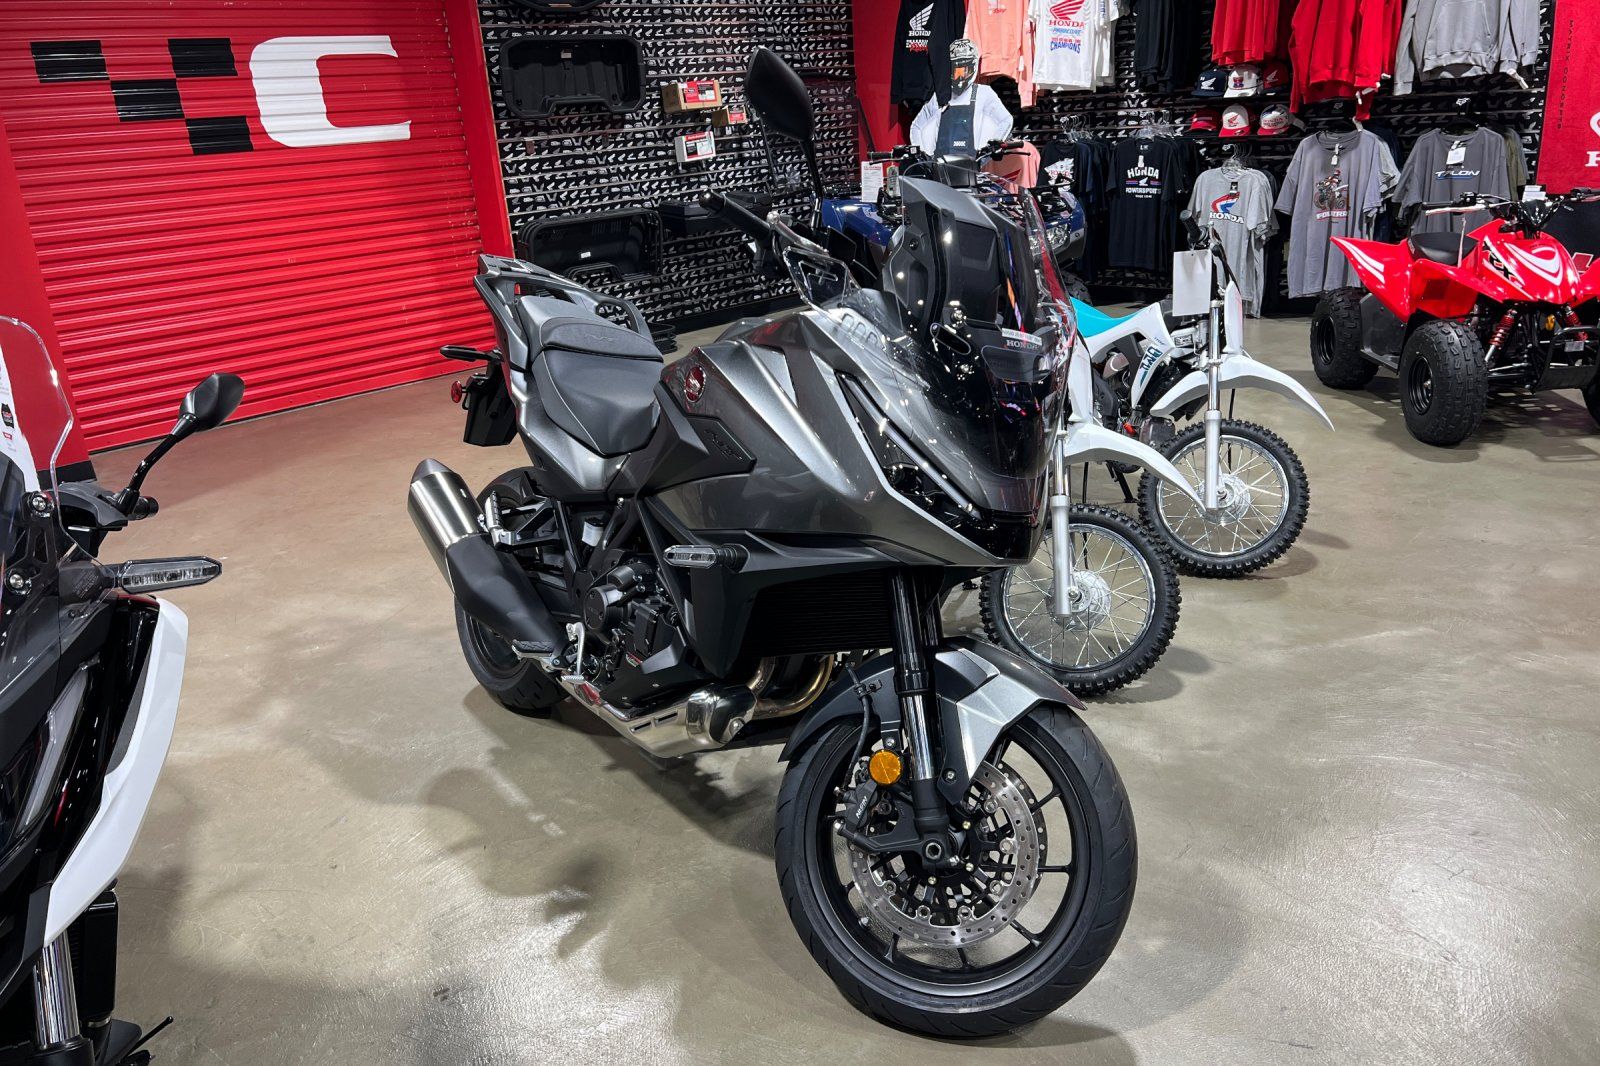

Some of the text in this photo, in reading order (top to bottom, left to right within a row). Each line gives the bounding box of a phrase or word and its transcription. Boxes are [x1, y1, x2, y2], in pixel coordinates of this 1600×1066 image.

[1049, 19, 1086, 28] HONDA
[1050, 41, 1081, 54] CHAMPIONS
[1557, 19, 1574, 130] MATRIX CONCEPTS
[1127, 166, 1160, 180] HONDA
[1209, 211, 1245, 224] HONDA
[1005, 339, 1040, 350] HONDA
